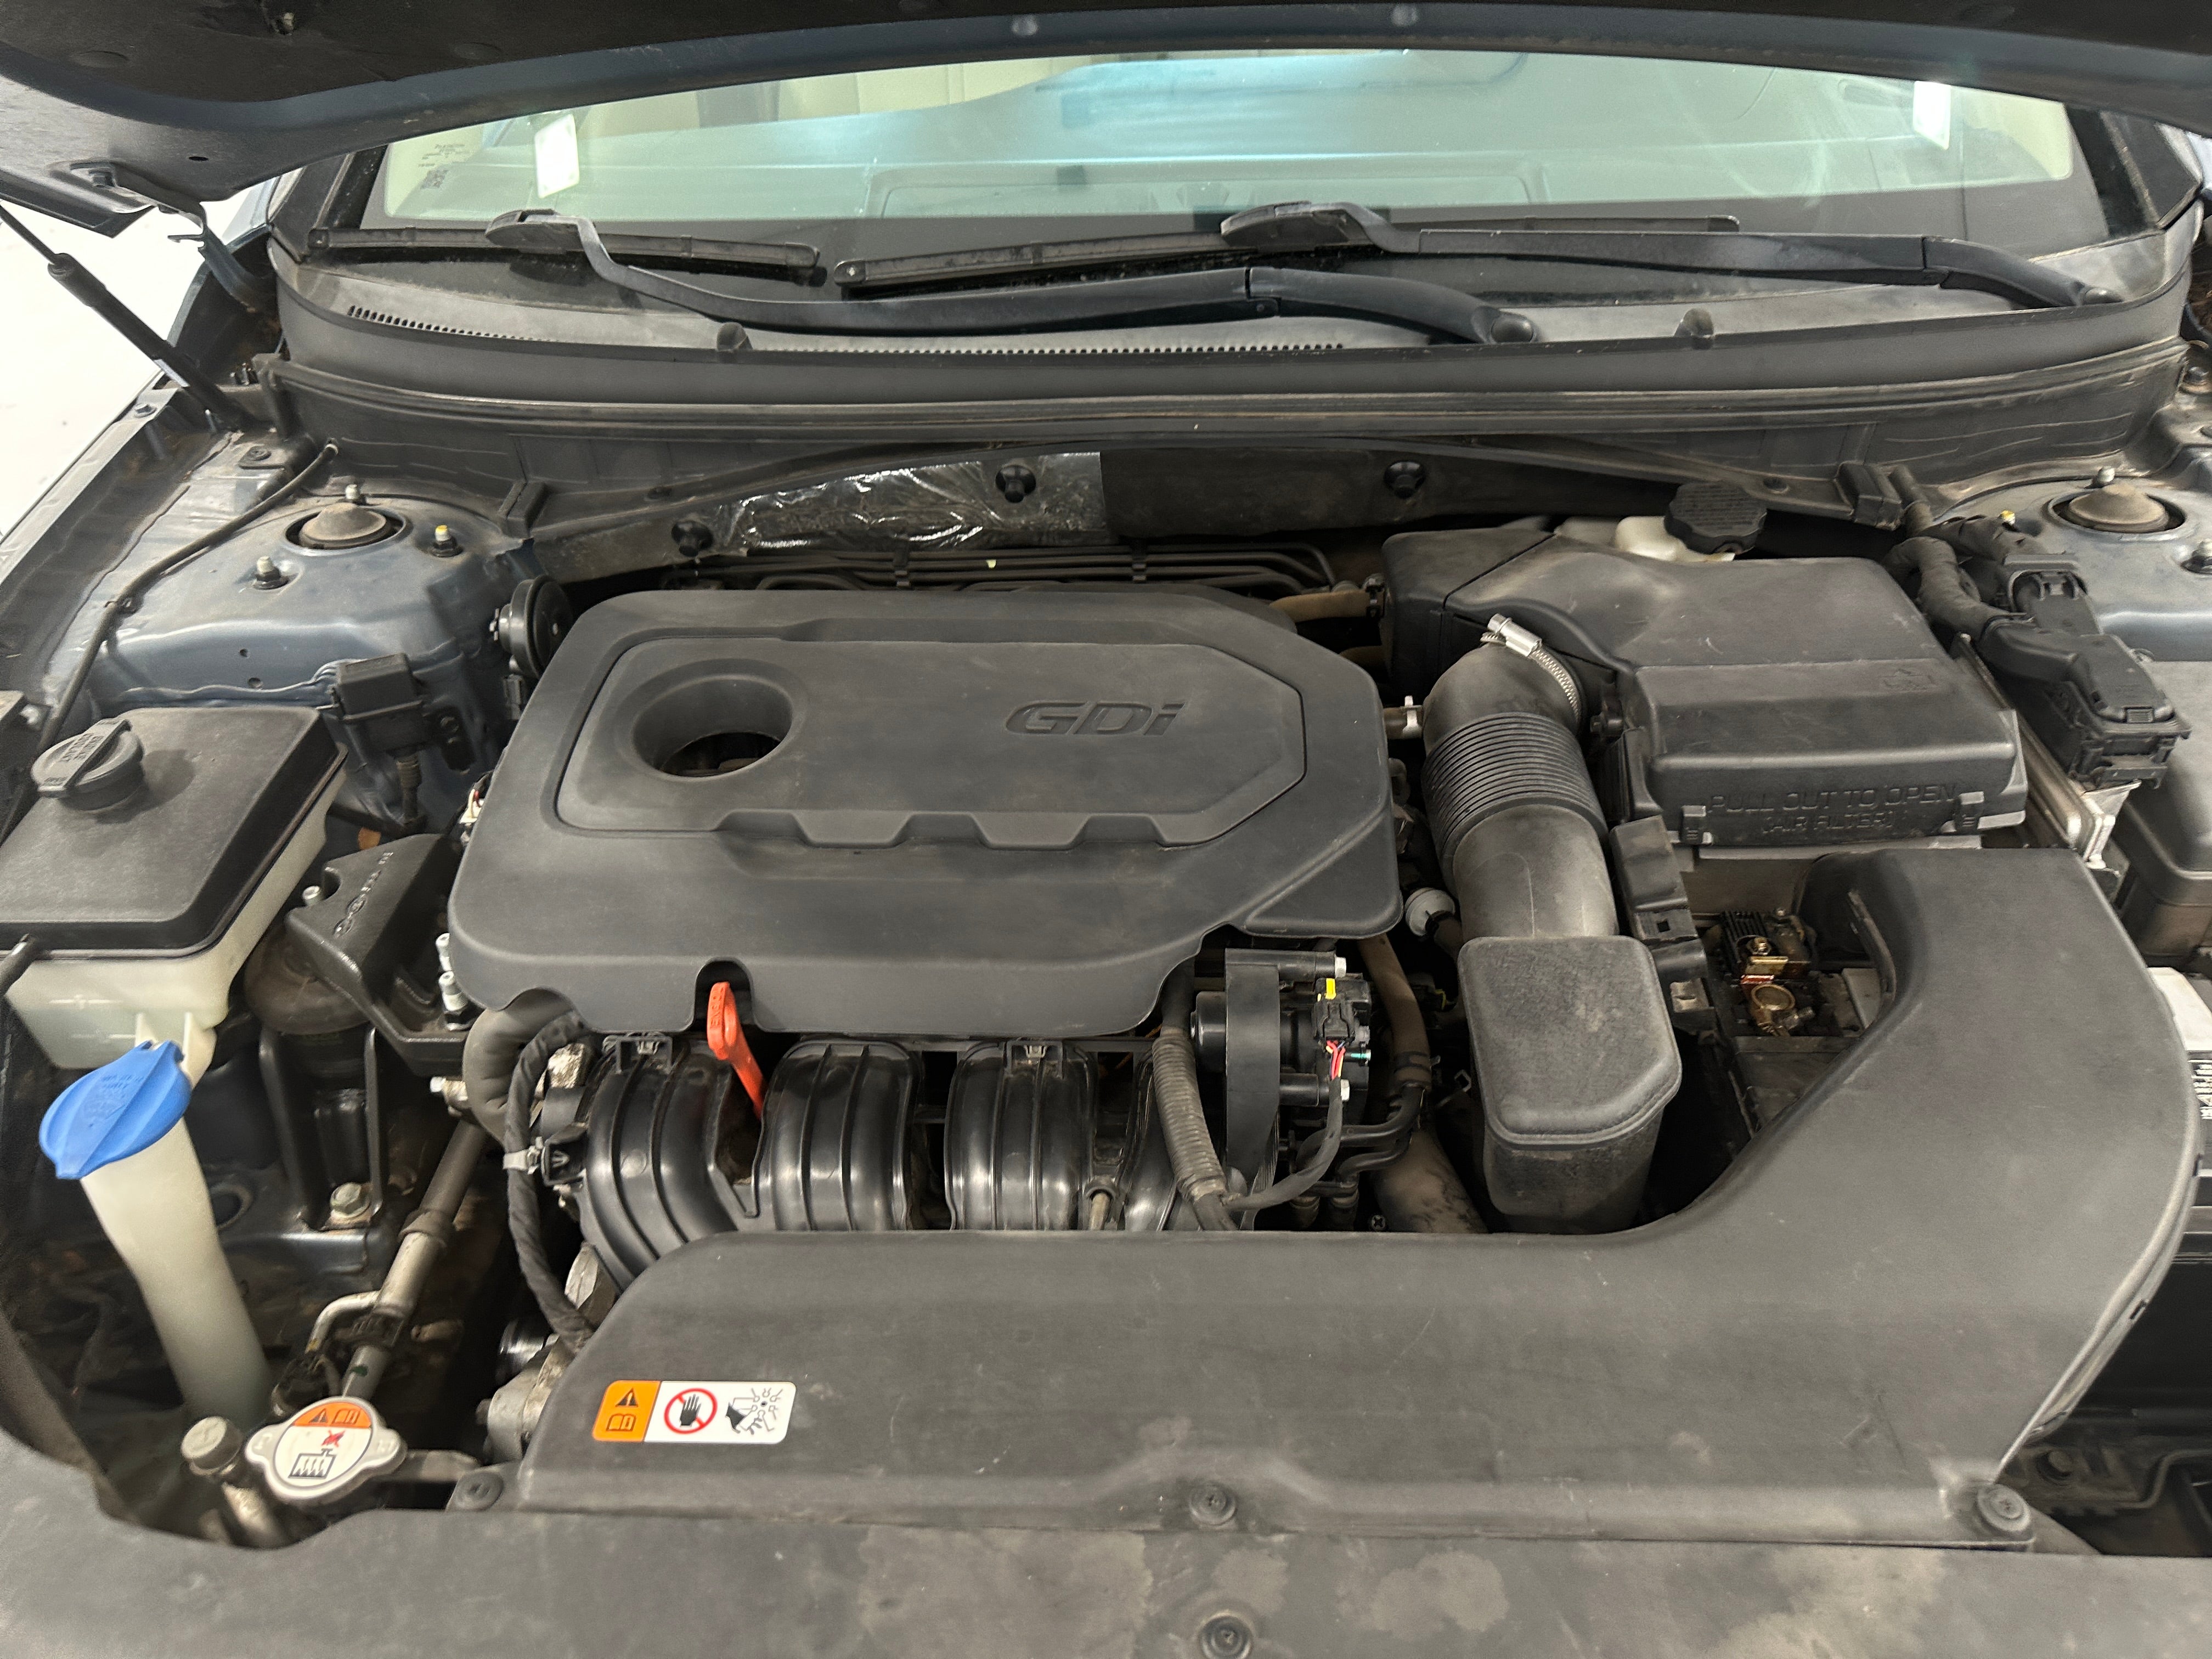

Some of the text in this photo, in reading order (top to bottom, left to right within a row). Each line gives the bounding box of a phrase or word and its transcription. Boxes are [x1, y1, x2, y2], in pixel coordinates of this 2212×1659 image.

[1005, 700, 1186, 736] GDi
[1706, 783, 1956, 812] PULL OUT TO OPEN
